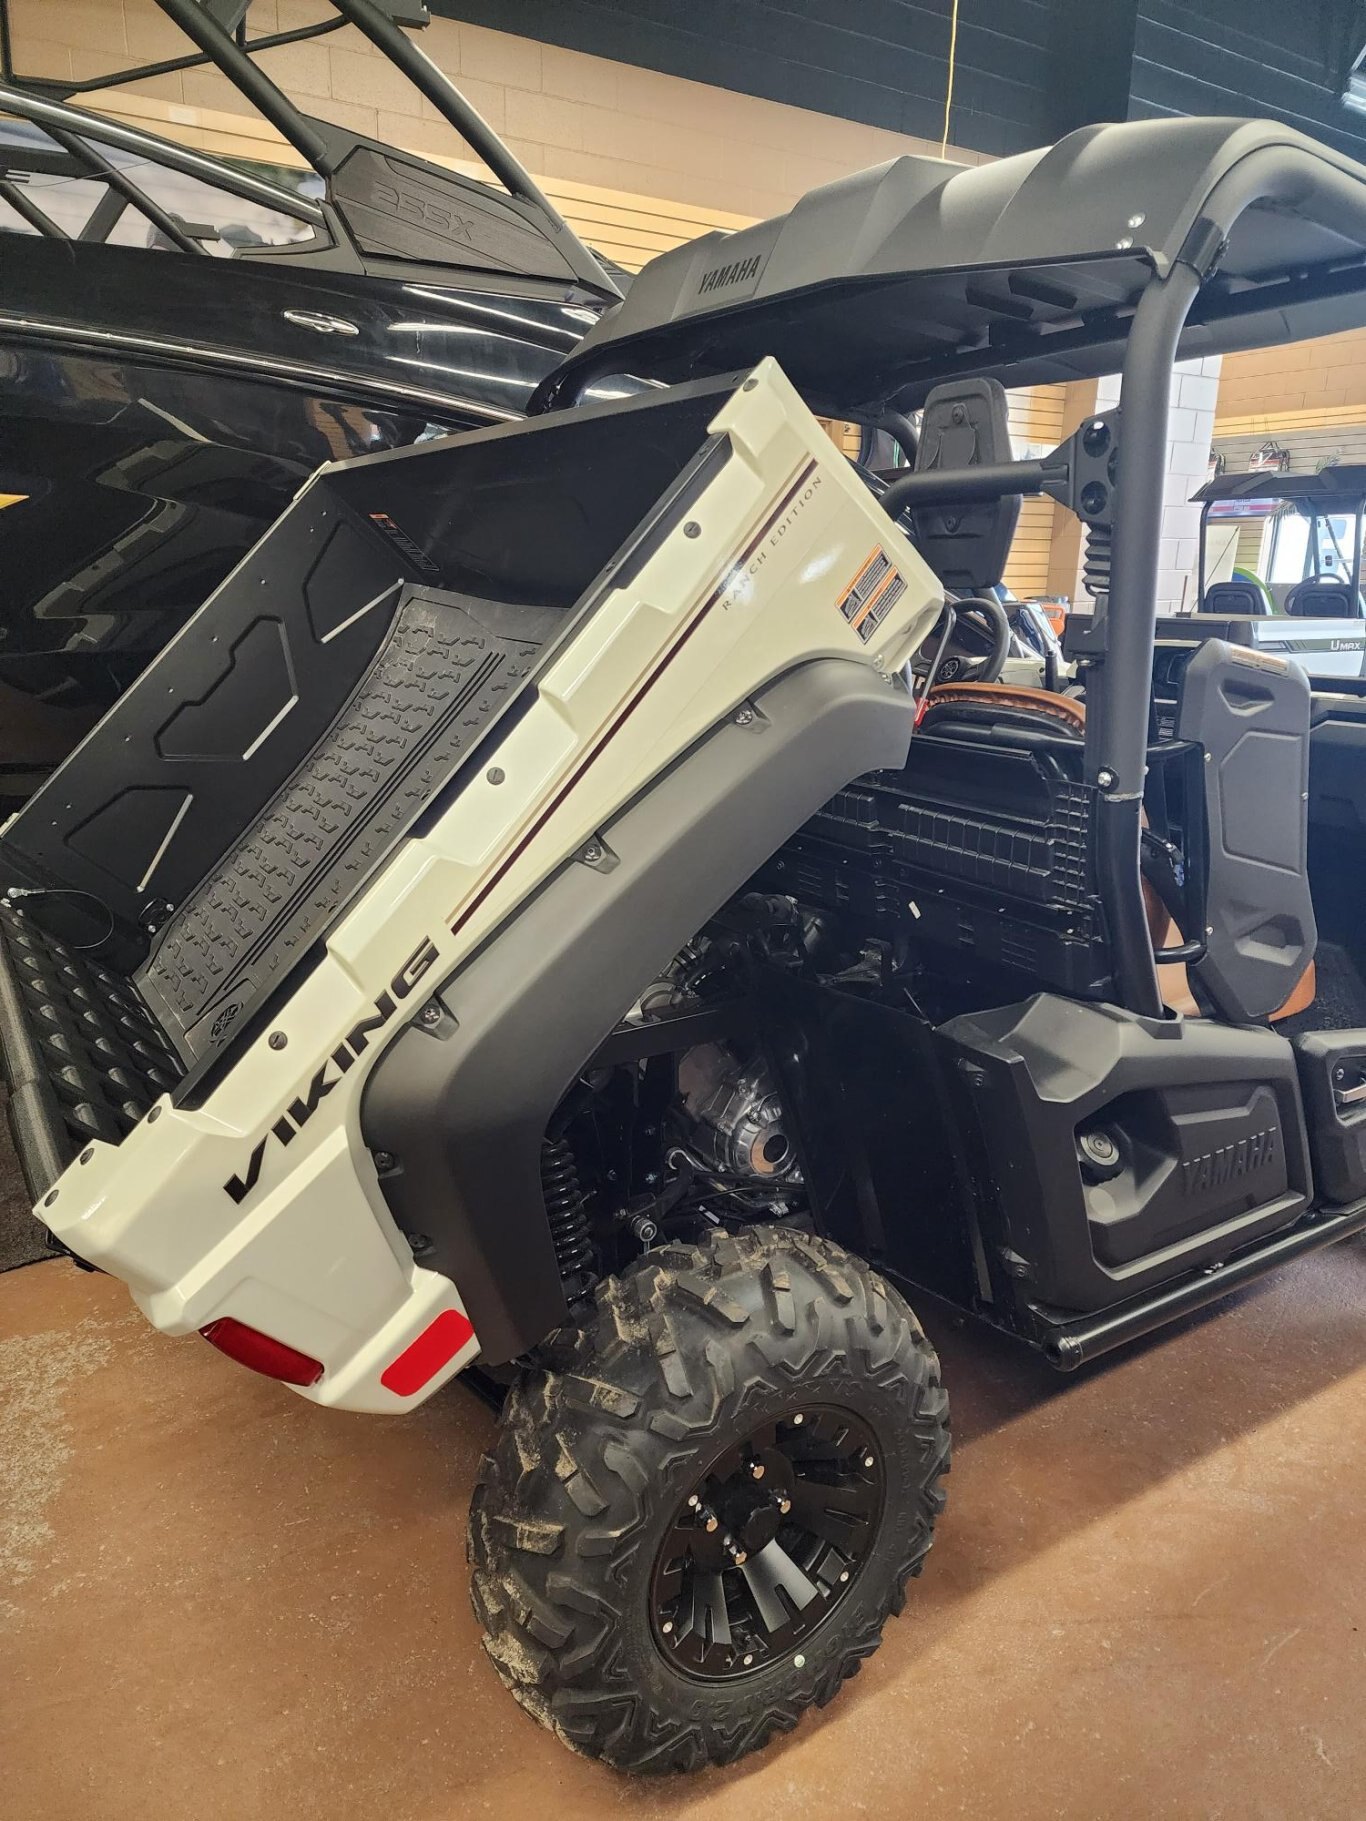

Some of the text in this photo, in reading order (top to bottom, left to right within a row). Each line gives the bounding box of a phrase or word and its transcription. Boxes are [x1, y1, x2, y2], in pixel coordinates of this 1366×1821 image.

[698, 254, 762, 295] YAMAHA
[722, 476, 822, 611] RANCH EDITION
[223, 935, 440, 1205] VIKING
[1182, 1126, 1277, 1196] YAMAHA
